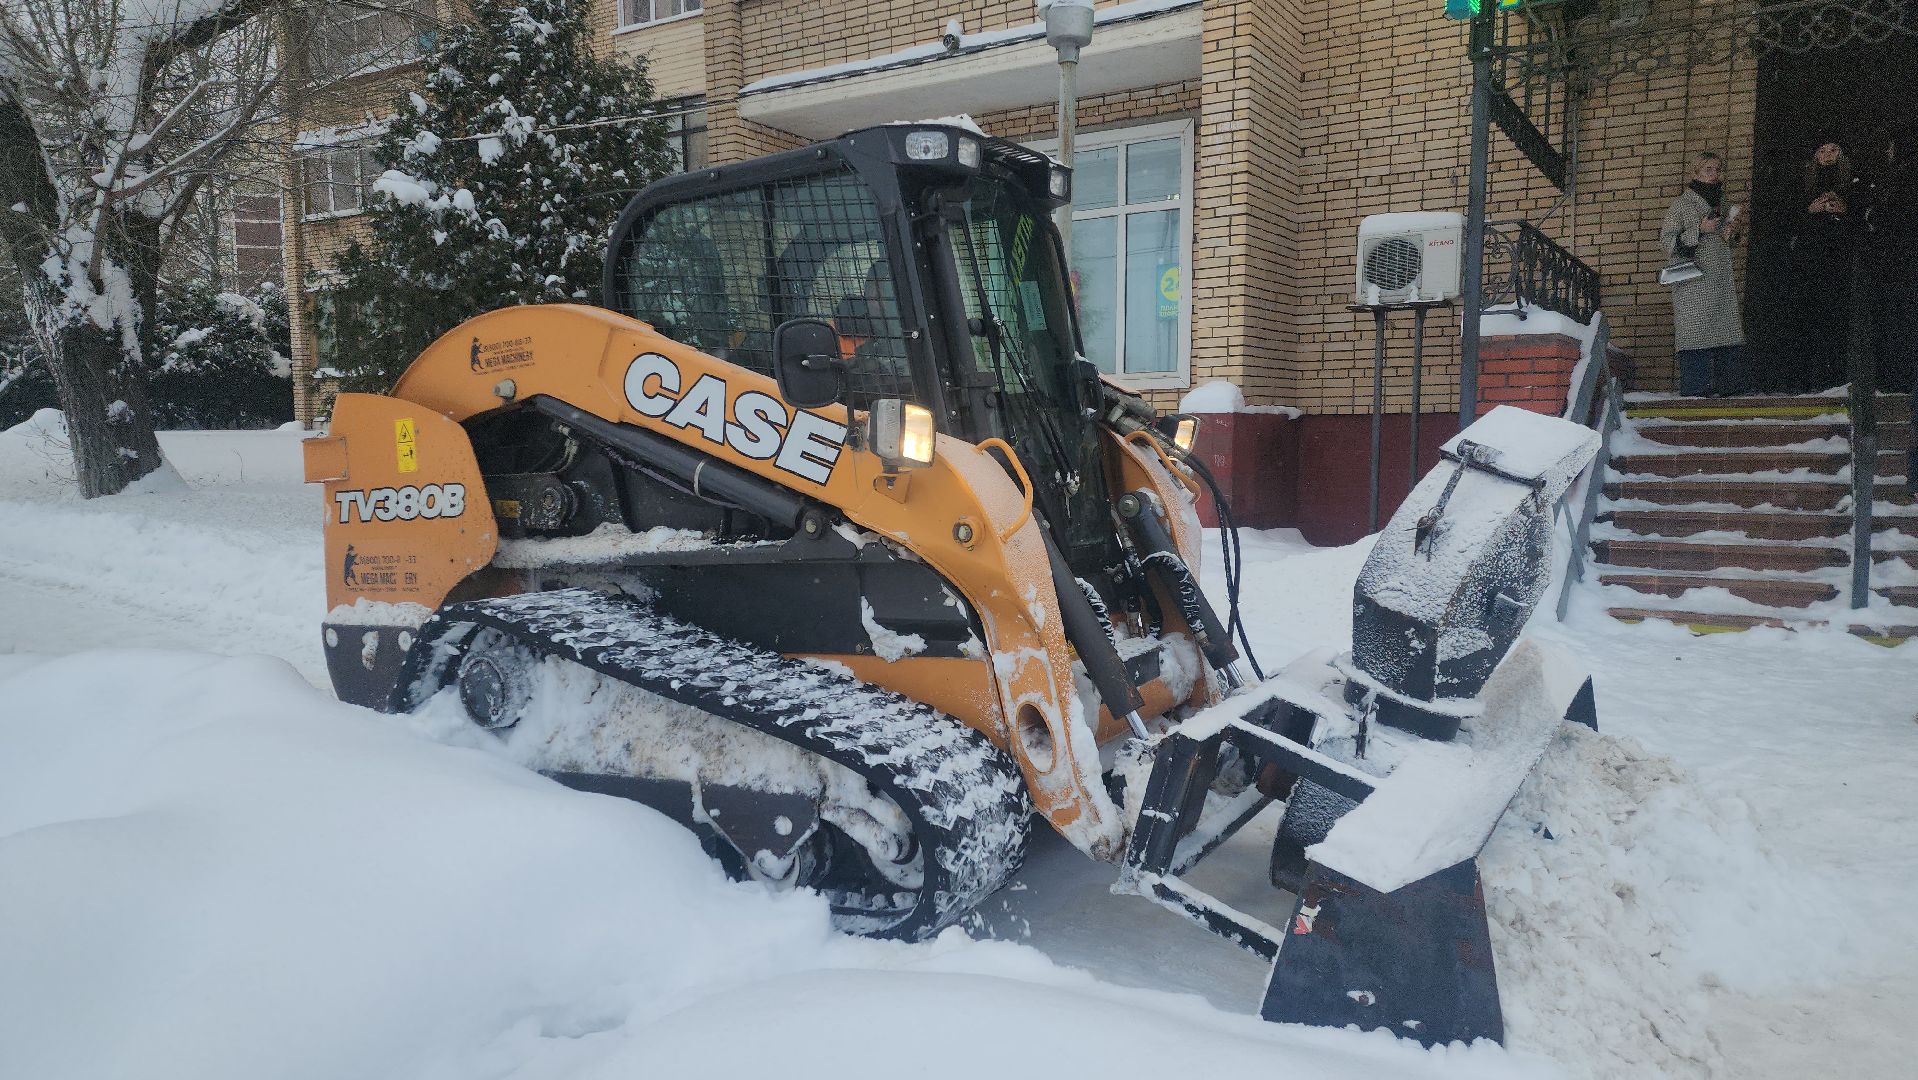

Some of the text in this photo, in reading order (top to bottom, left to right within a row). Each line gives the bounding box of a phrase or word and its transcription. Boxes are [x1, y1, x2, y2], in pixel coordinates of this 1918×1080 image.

[623, 352, 848, 487] CASE
[335, 483, 465, 524] TV380B
[360, 572, 378, 585] MEGA
